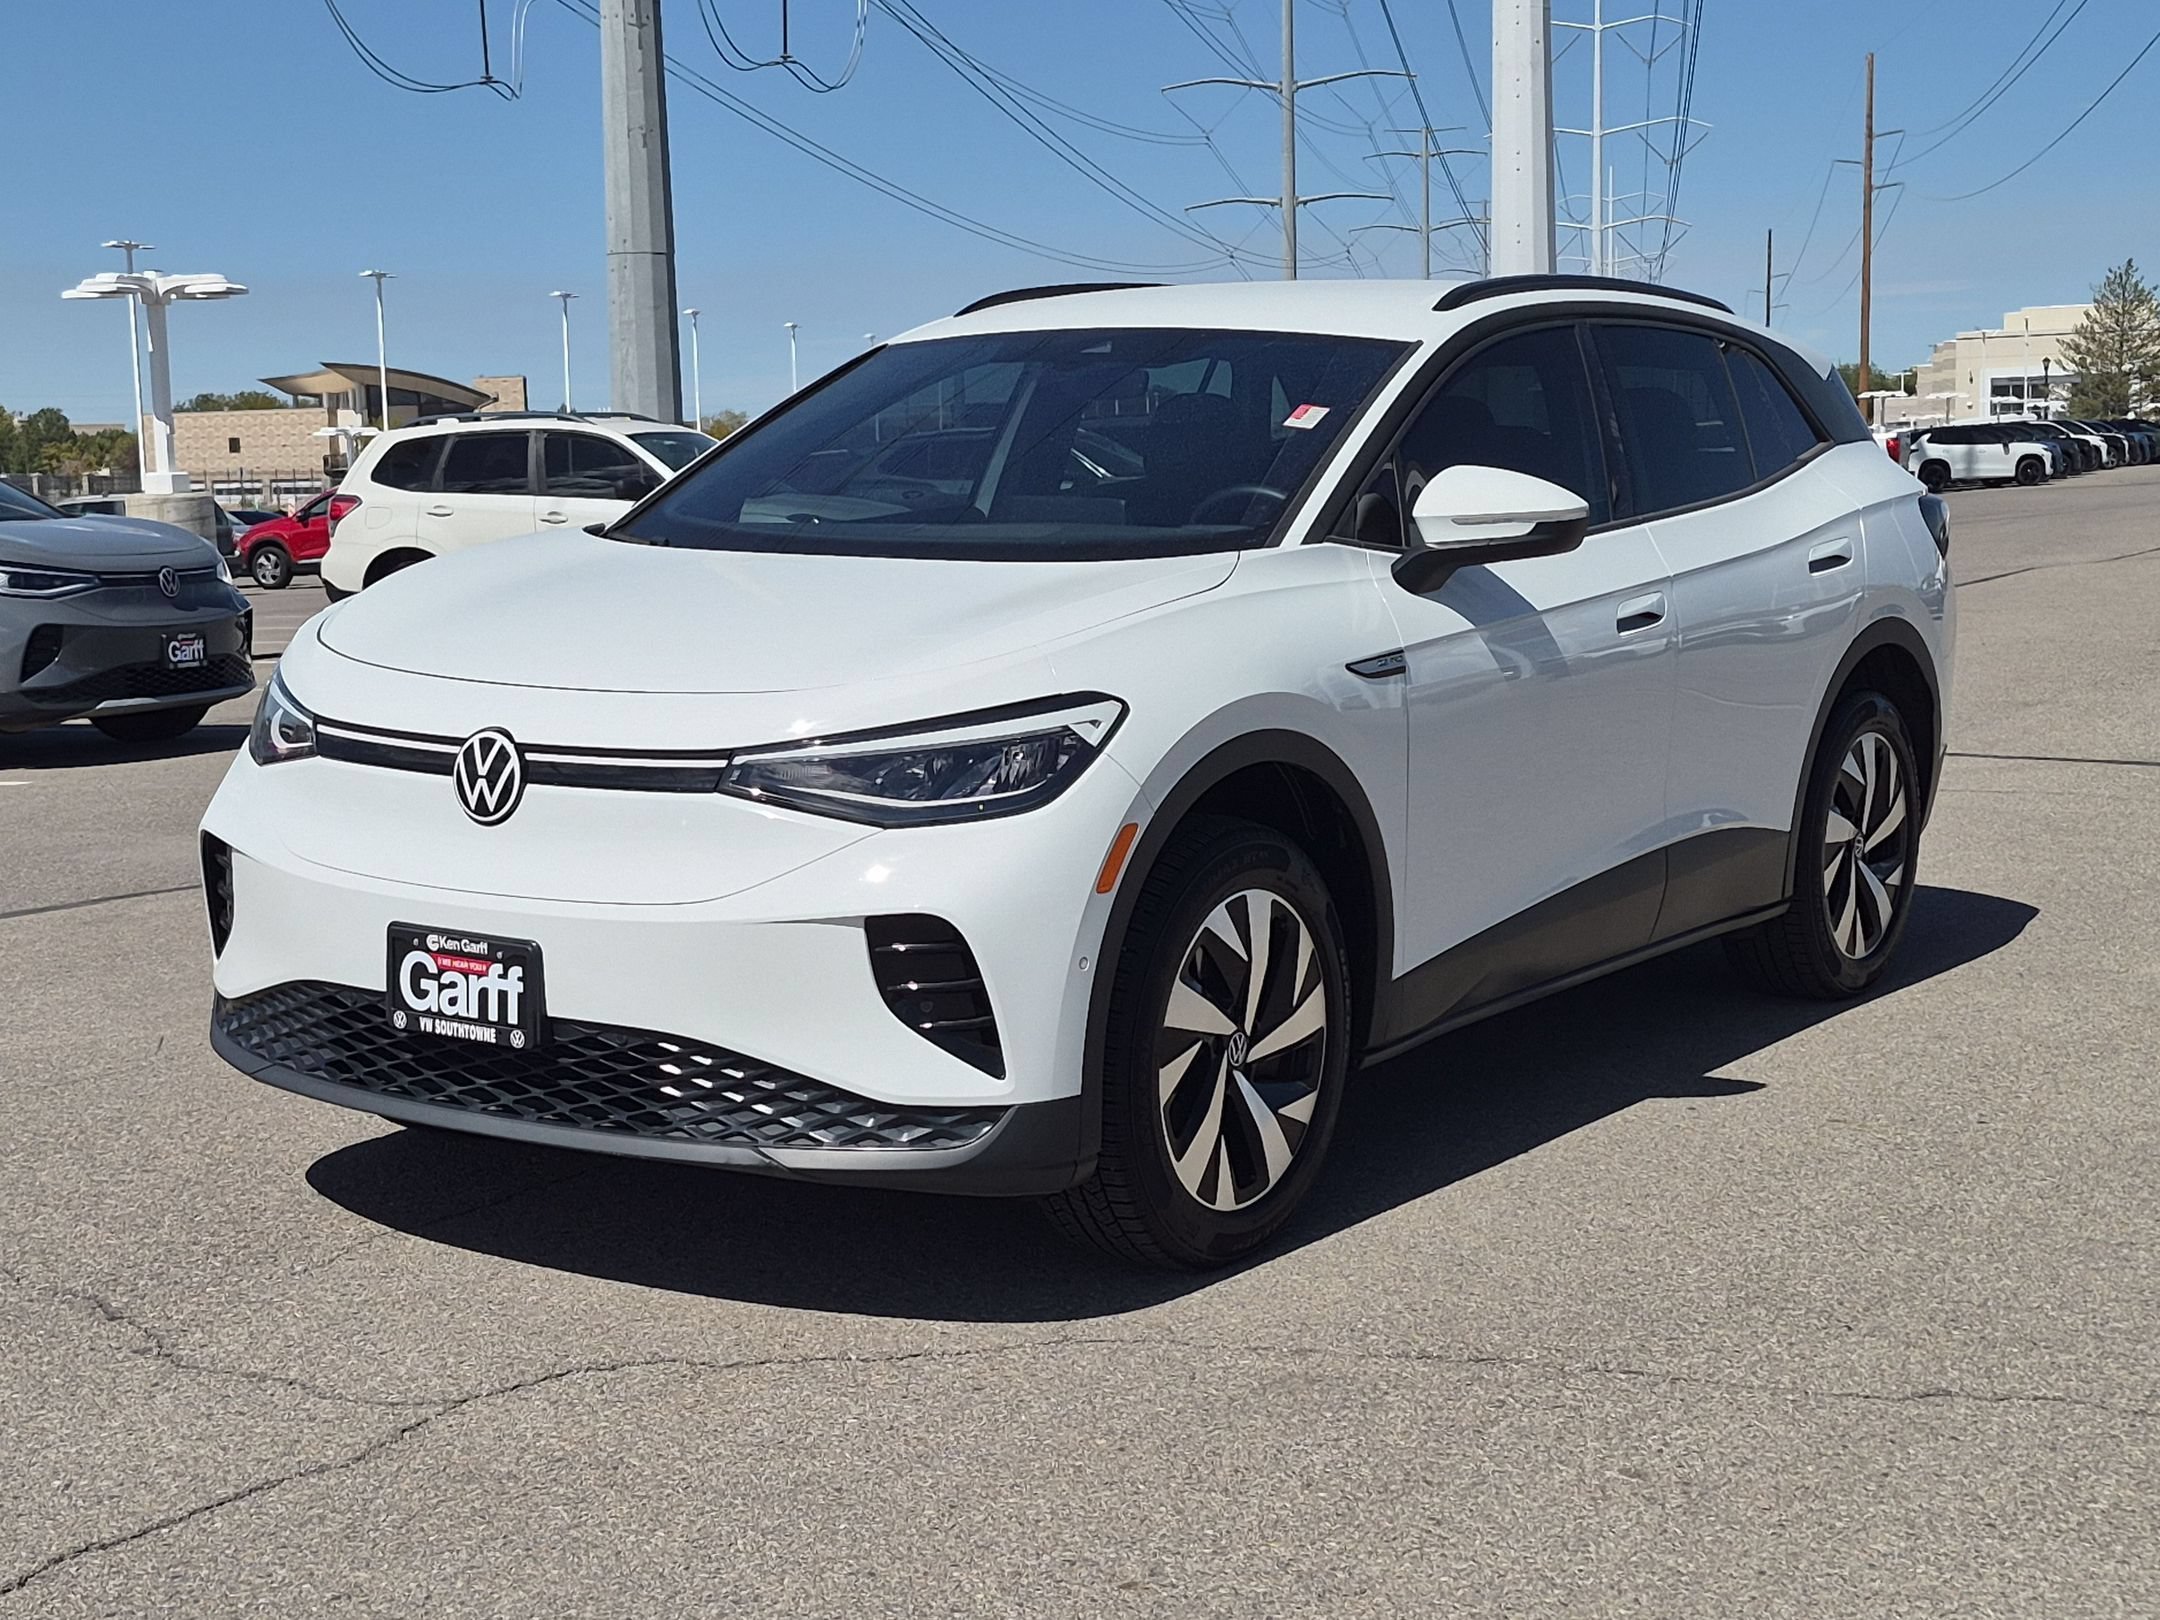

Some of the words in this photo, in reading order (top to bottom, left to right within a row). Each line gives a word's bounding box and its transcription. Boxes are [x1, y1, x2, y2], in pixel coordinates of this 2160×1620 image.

[168, 639, 204, 662] Garff
[453, 731, 521, 822] VW
[439, 935, 460, 951] Ken
[461, 939, 488, 955] Garff
[400, 950, 524, 1025] Garff
[419, 1016, 434, 1032] VW
[434, 1018, 497, 1044] SOUTHTOWNE
